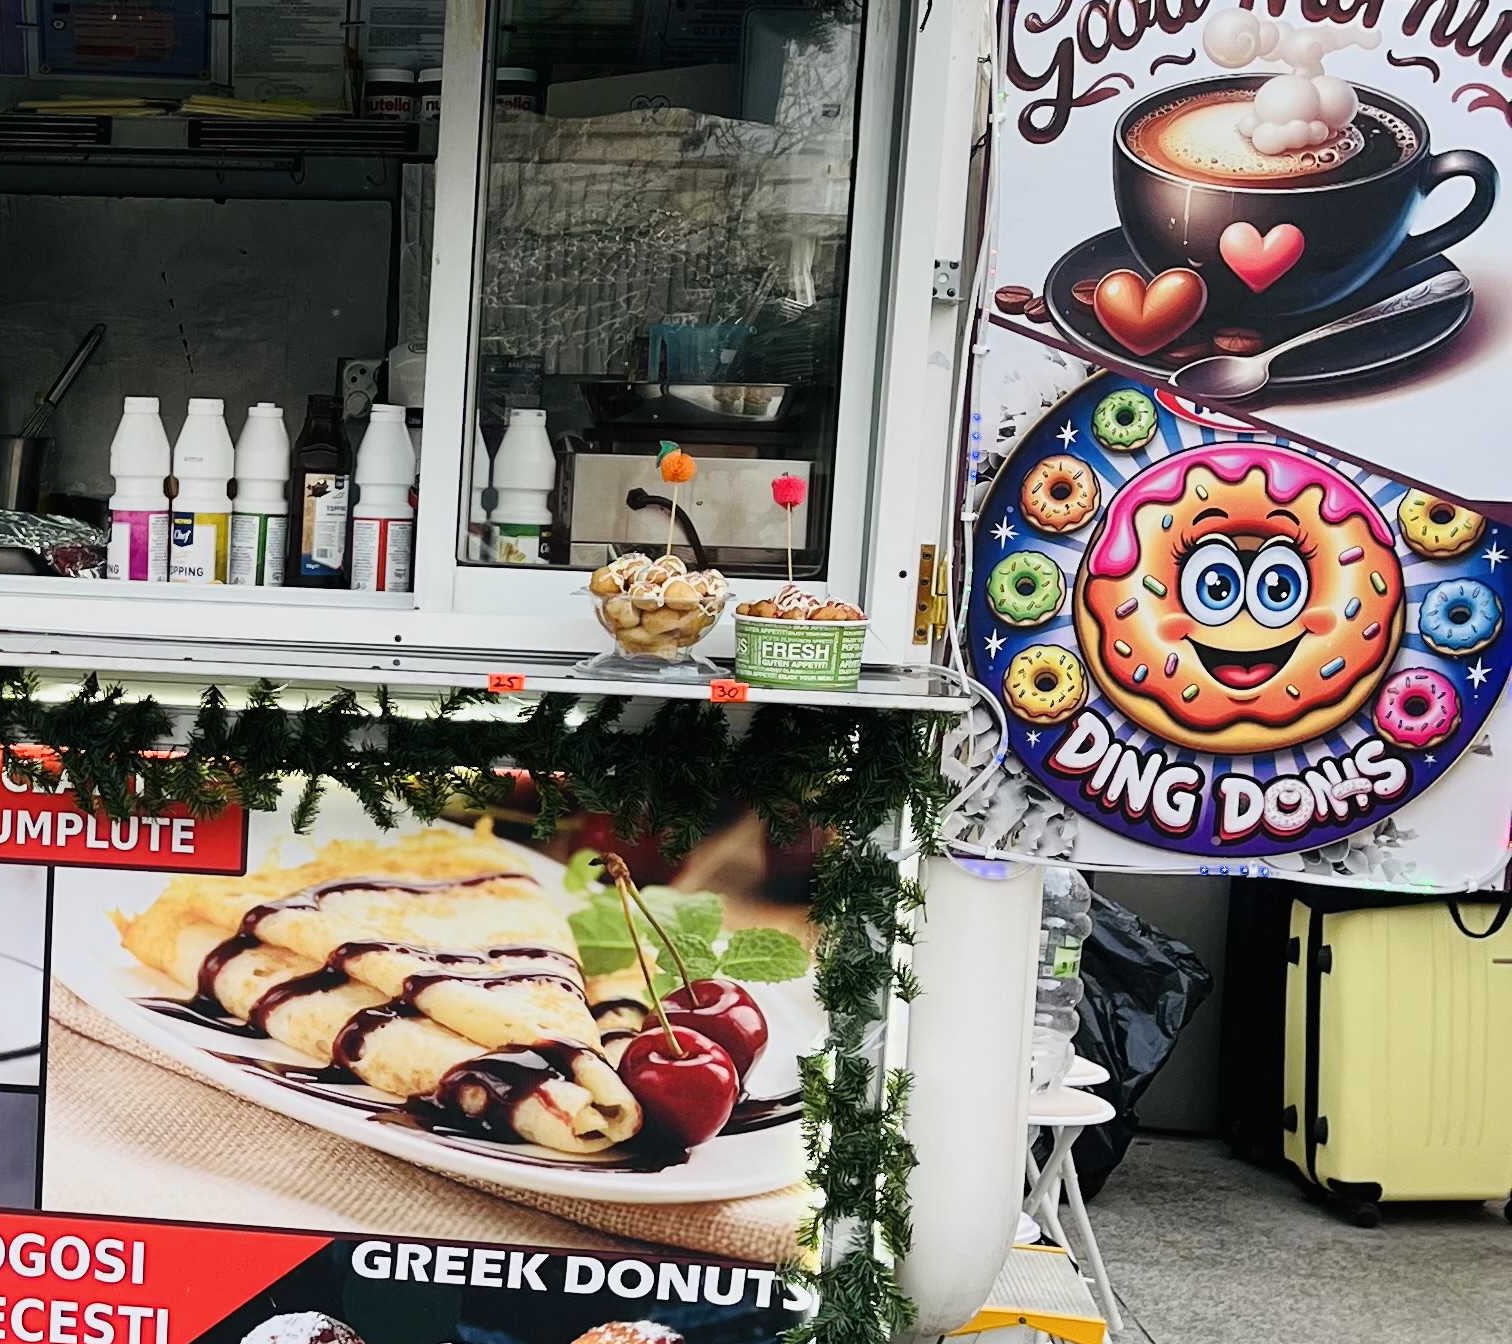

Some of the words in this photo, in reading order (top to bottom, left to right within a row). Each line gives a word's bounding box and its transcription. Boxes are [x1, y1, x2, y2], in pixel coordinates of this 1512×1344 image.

[761, 640, 830, 660] FRESH
[493, 676, 519, 688] 25
[717, 686, 738, 698] 30
[1050, 711, 1199, 832] DING
[351, 1240, 552, 1292] GREEK
[563, 1255, 815, 1312] DONUTS
